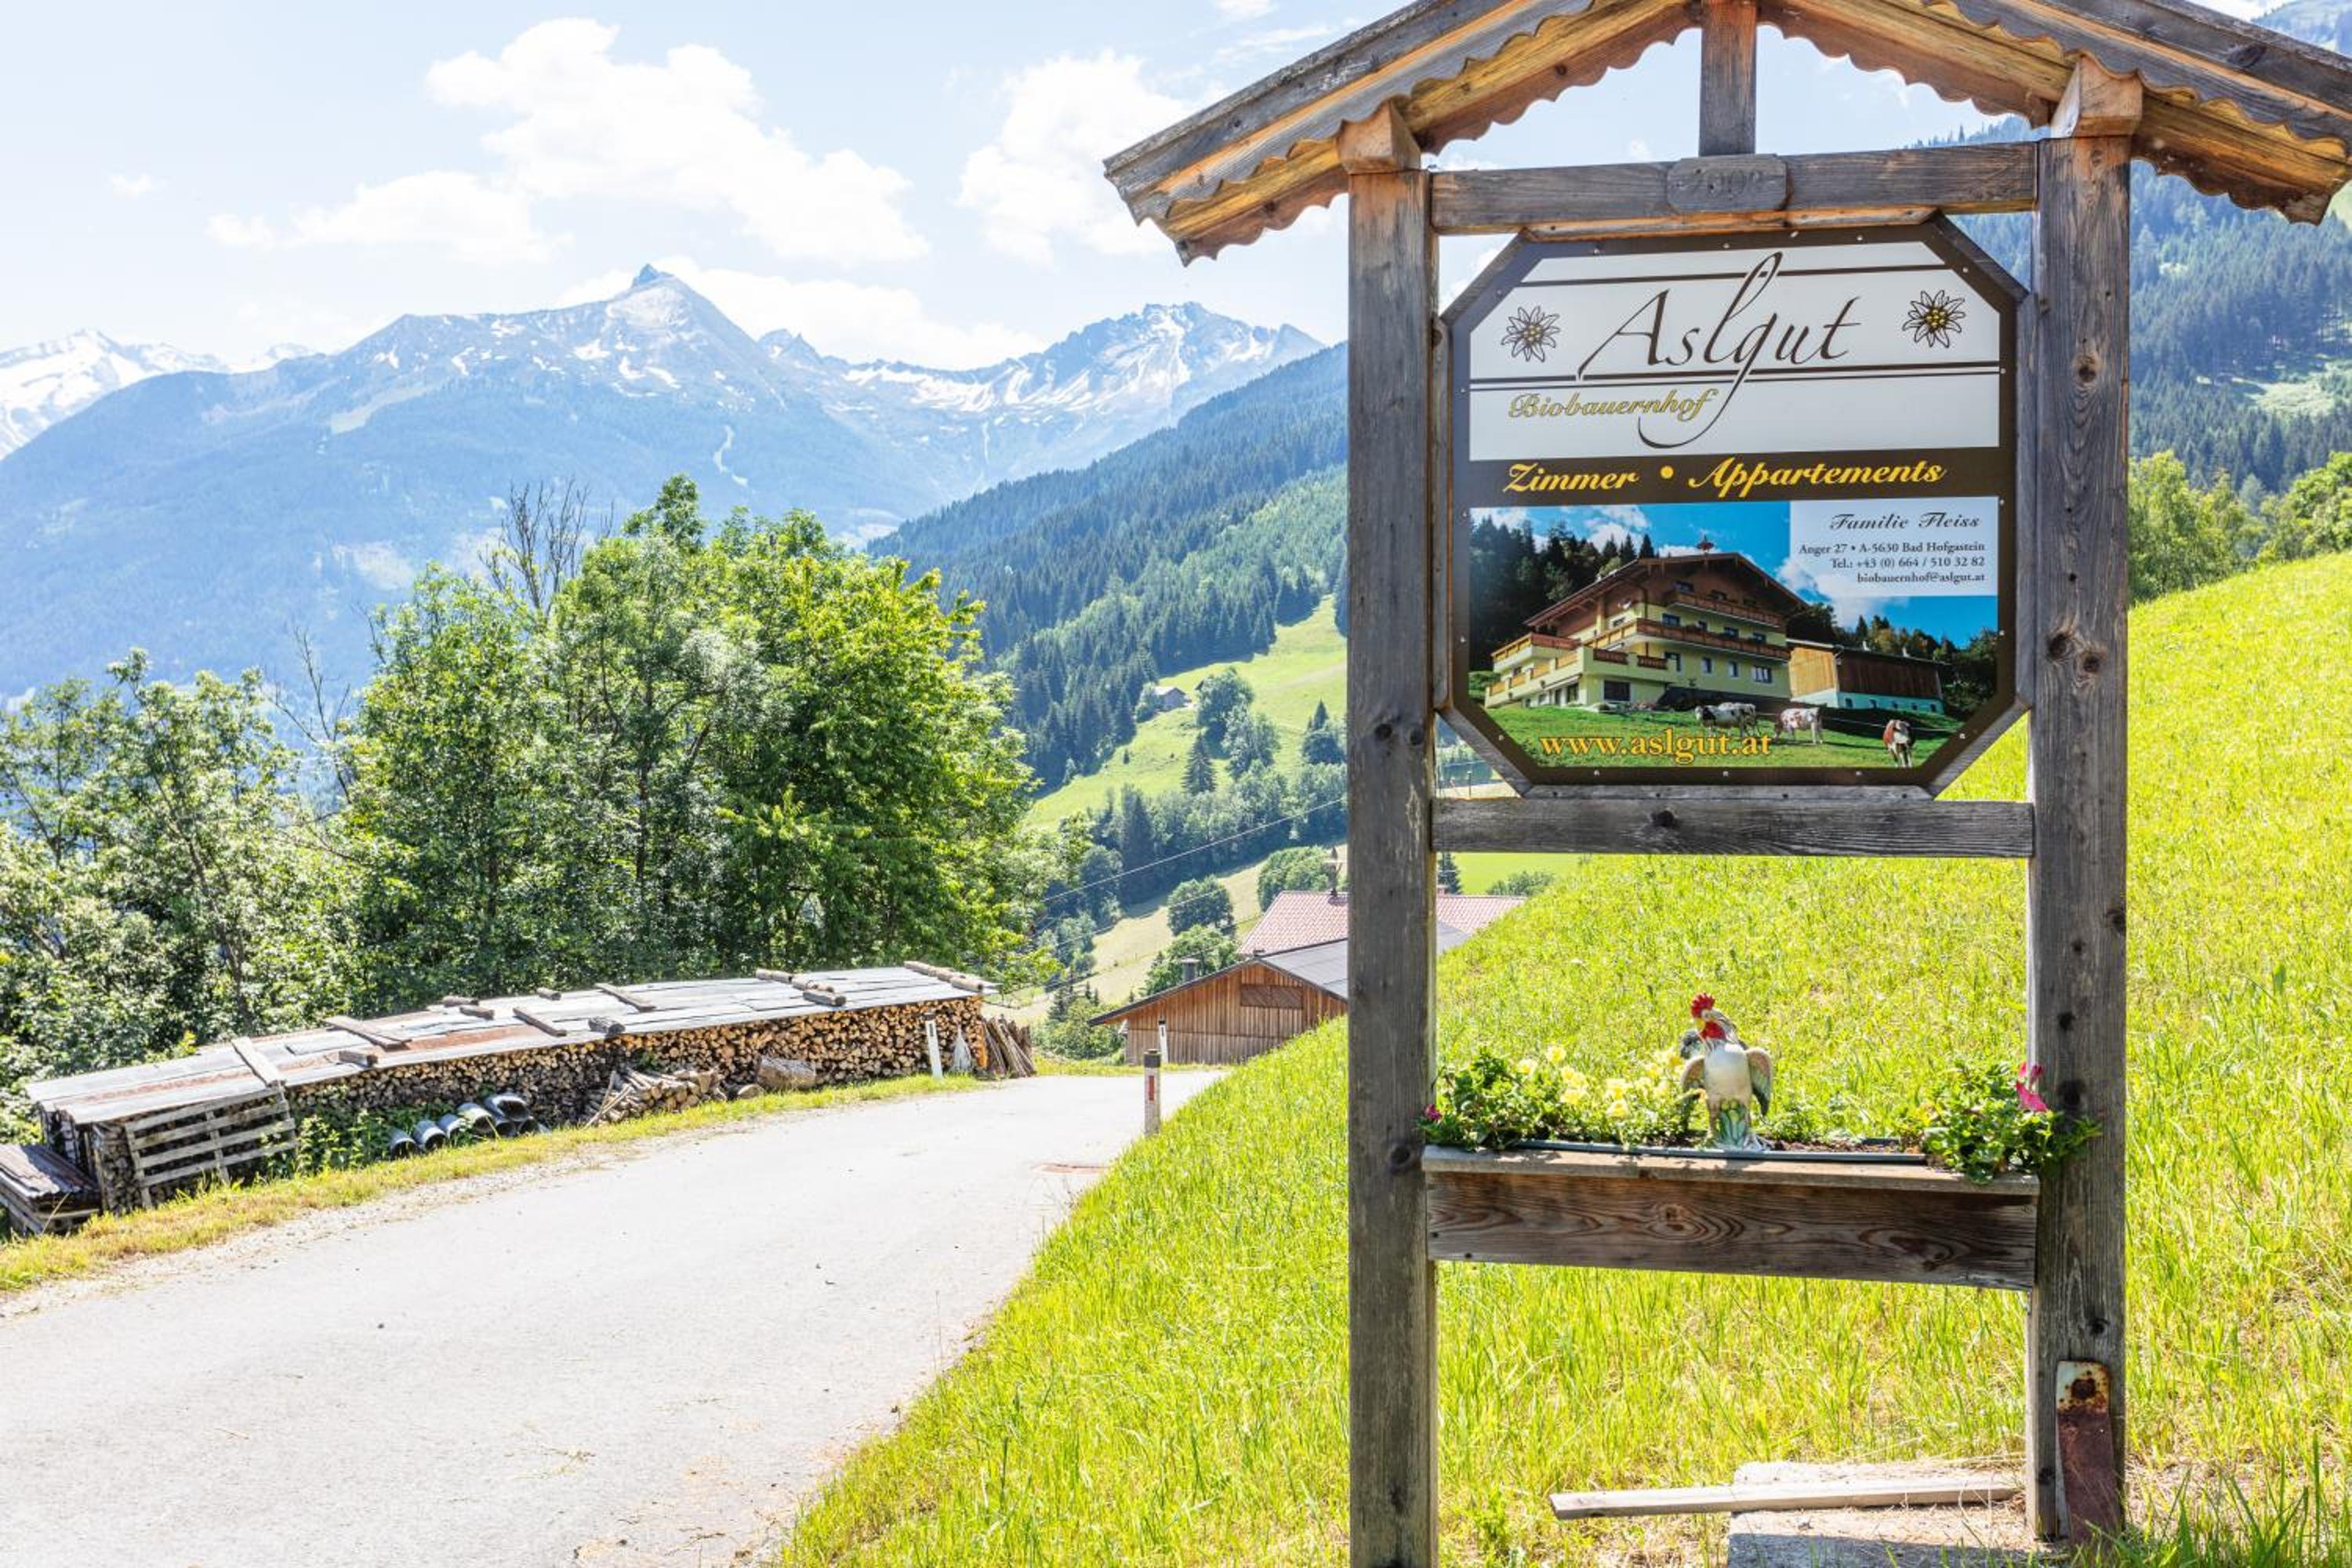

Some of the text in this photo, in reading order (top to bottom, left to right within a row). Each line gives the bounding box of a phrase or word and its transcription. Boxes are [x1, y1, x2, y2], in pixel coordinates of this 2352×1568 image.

[1576, 251, 1864, 449] Aslgut
[1508, 388, 1719, 423] Biobauernhof
[1502, 456, 1947, 498] Zimmer Appartements
[1830, 512, 1980, 530] Familie Fleiss
[1799, 541, 1986, 557] Anger 27 A-5630 Bad Hofgastein
[1831, 558, 1853, 568] Tel.:
[1857, 559, 1877, 568] +43
[1882, 557, 1895, 569] (0)
[1898, 557, 1919, 568] 664
[1930, 557, 1951, 567] 510
[1955, 557, 1968, 567] 32
[1971, 557, 1985, 566] 82
[1857, 572, 1986, 584] biobauernhof@aslgut.at
[1539, 728, 1773, 764] www.aslgut.at
